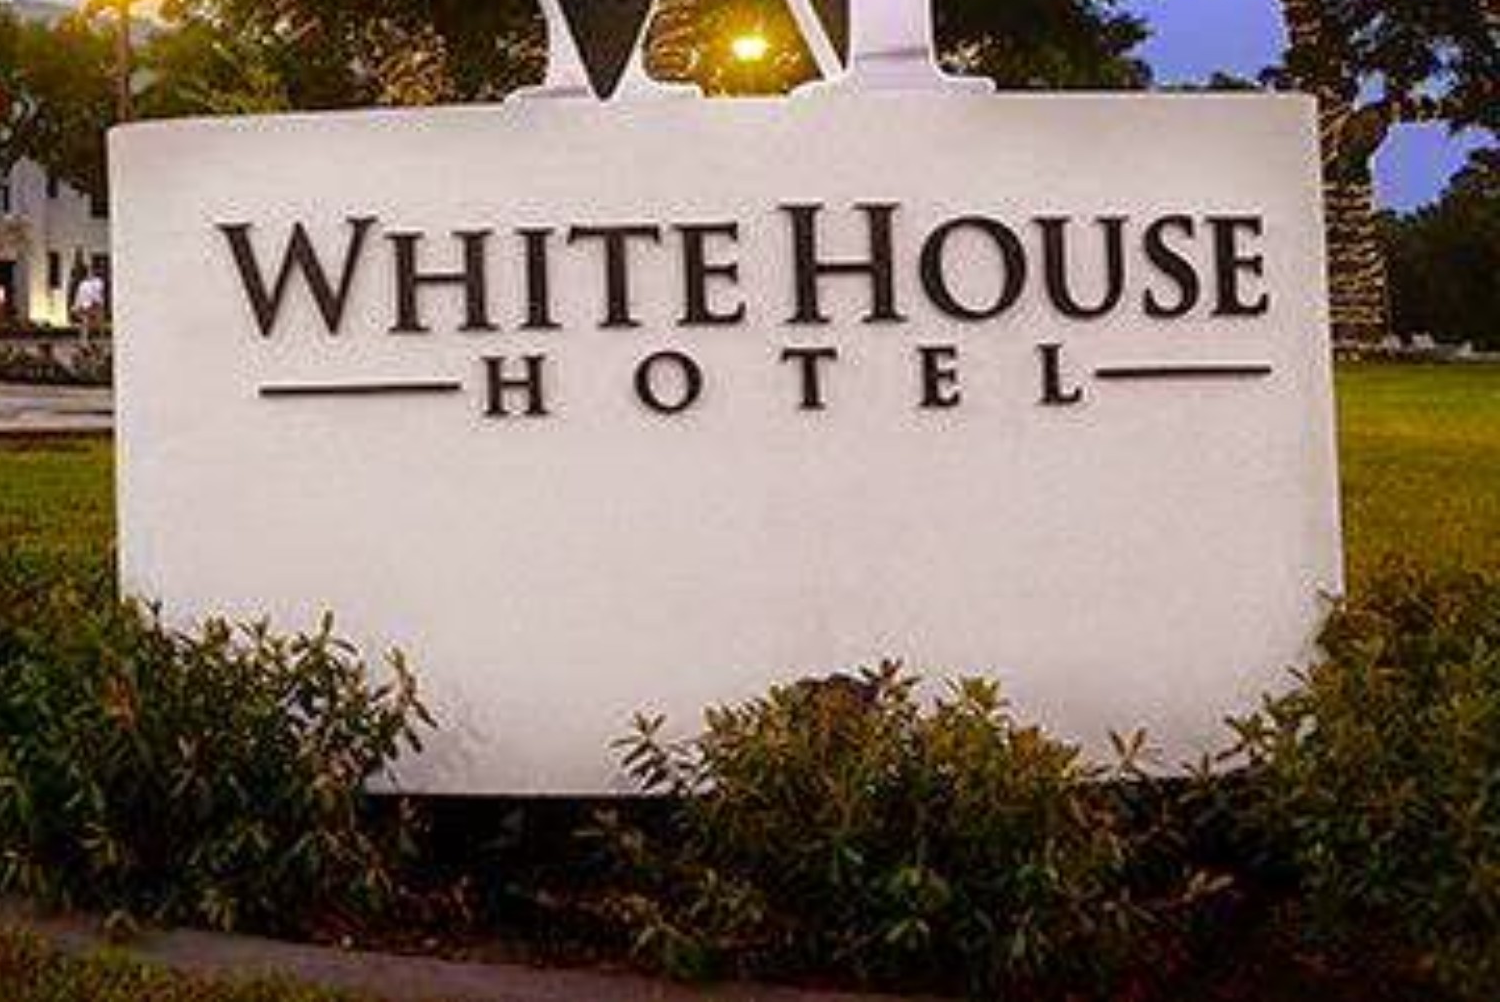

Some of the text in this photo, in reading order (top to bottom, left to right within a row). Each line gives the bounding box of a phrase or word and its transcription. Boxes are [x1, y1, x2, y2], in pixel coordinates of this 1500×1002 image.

[214, 201, 1272, 339] WHITE HOUSE
[478, 341, 1086, 420] HOTEL
